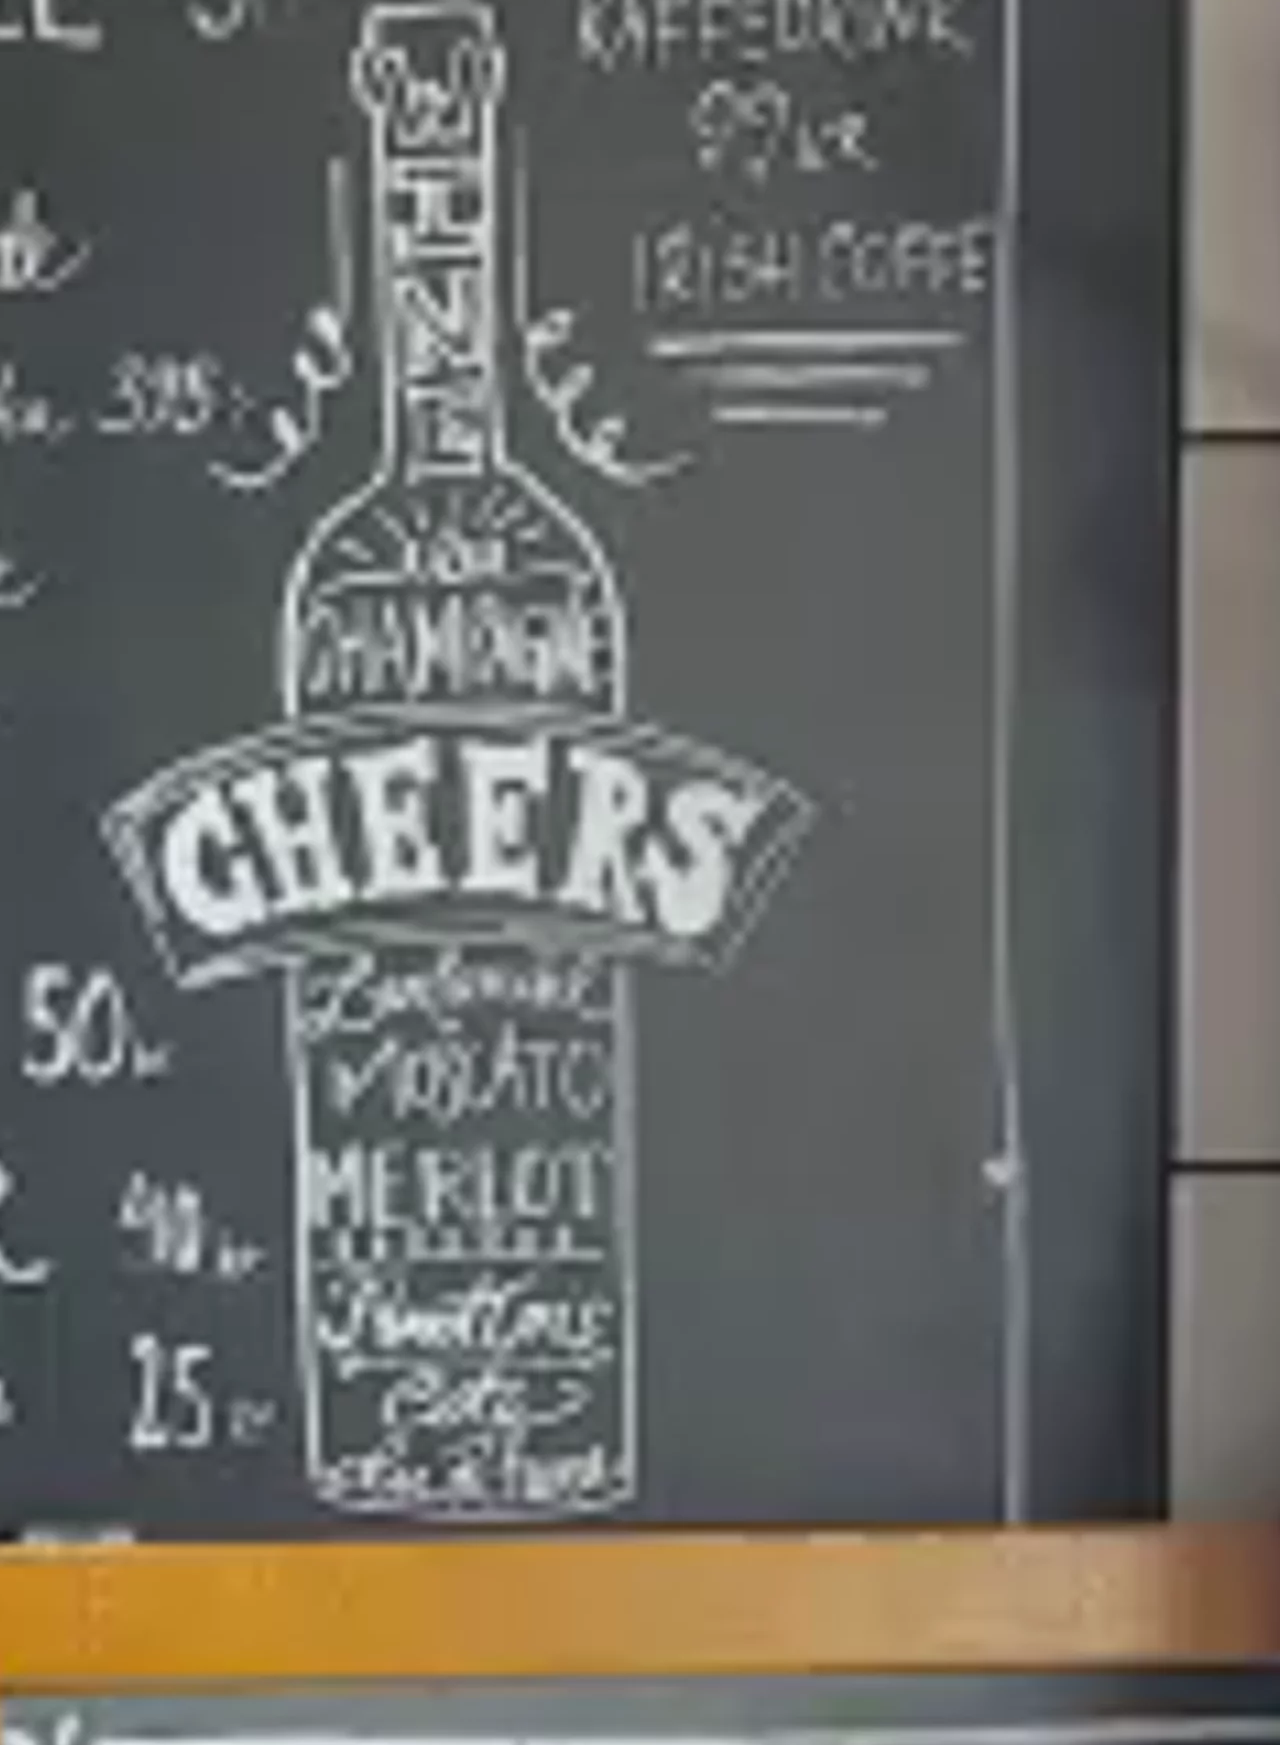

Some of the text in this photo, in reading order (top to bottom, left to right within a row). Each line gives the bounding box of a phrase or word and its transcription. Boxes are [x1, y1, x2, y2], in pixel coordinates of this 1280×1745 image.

[630, 222, 808, 316] IRISH
[162, 736, 762, 936] CHEERS
[308, 1140, 614, 1230] MERLOT
